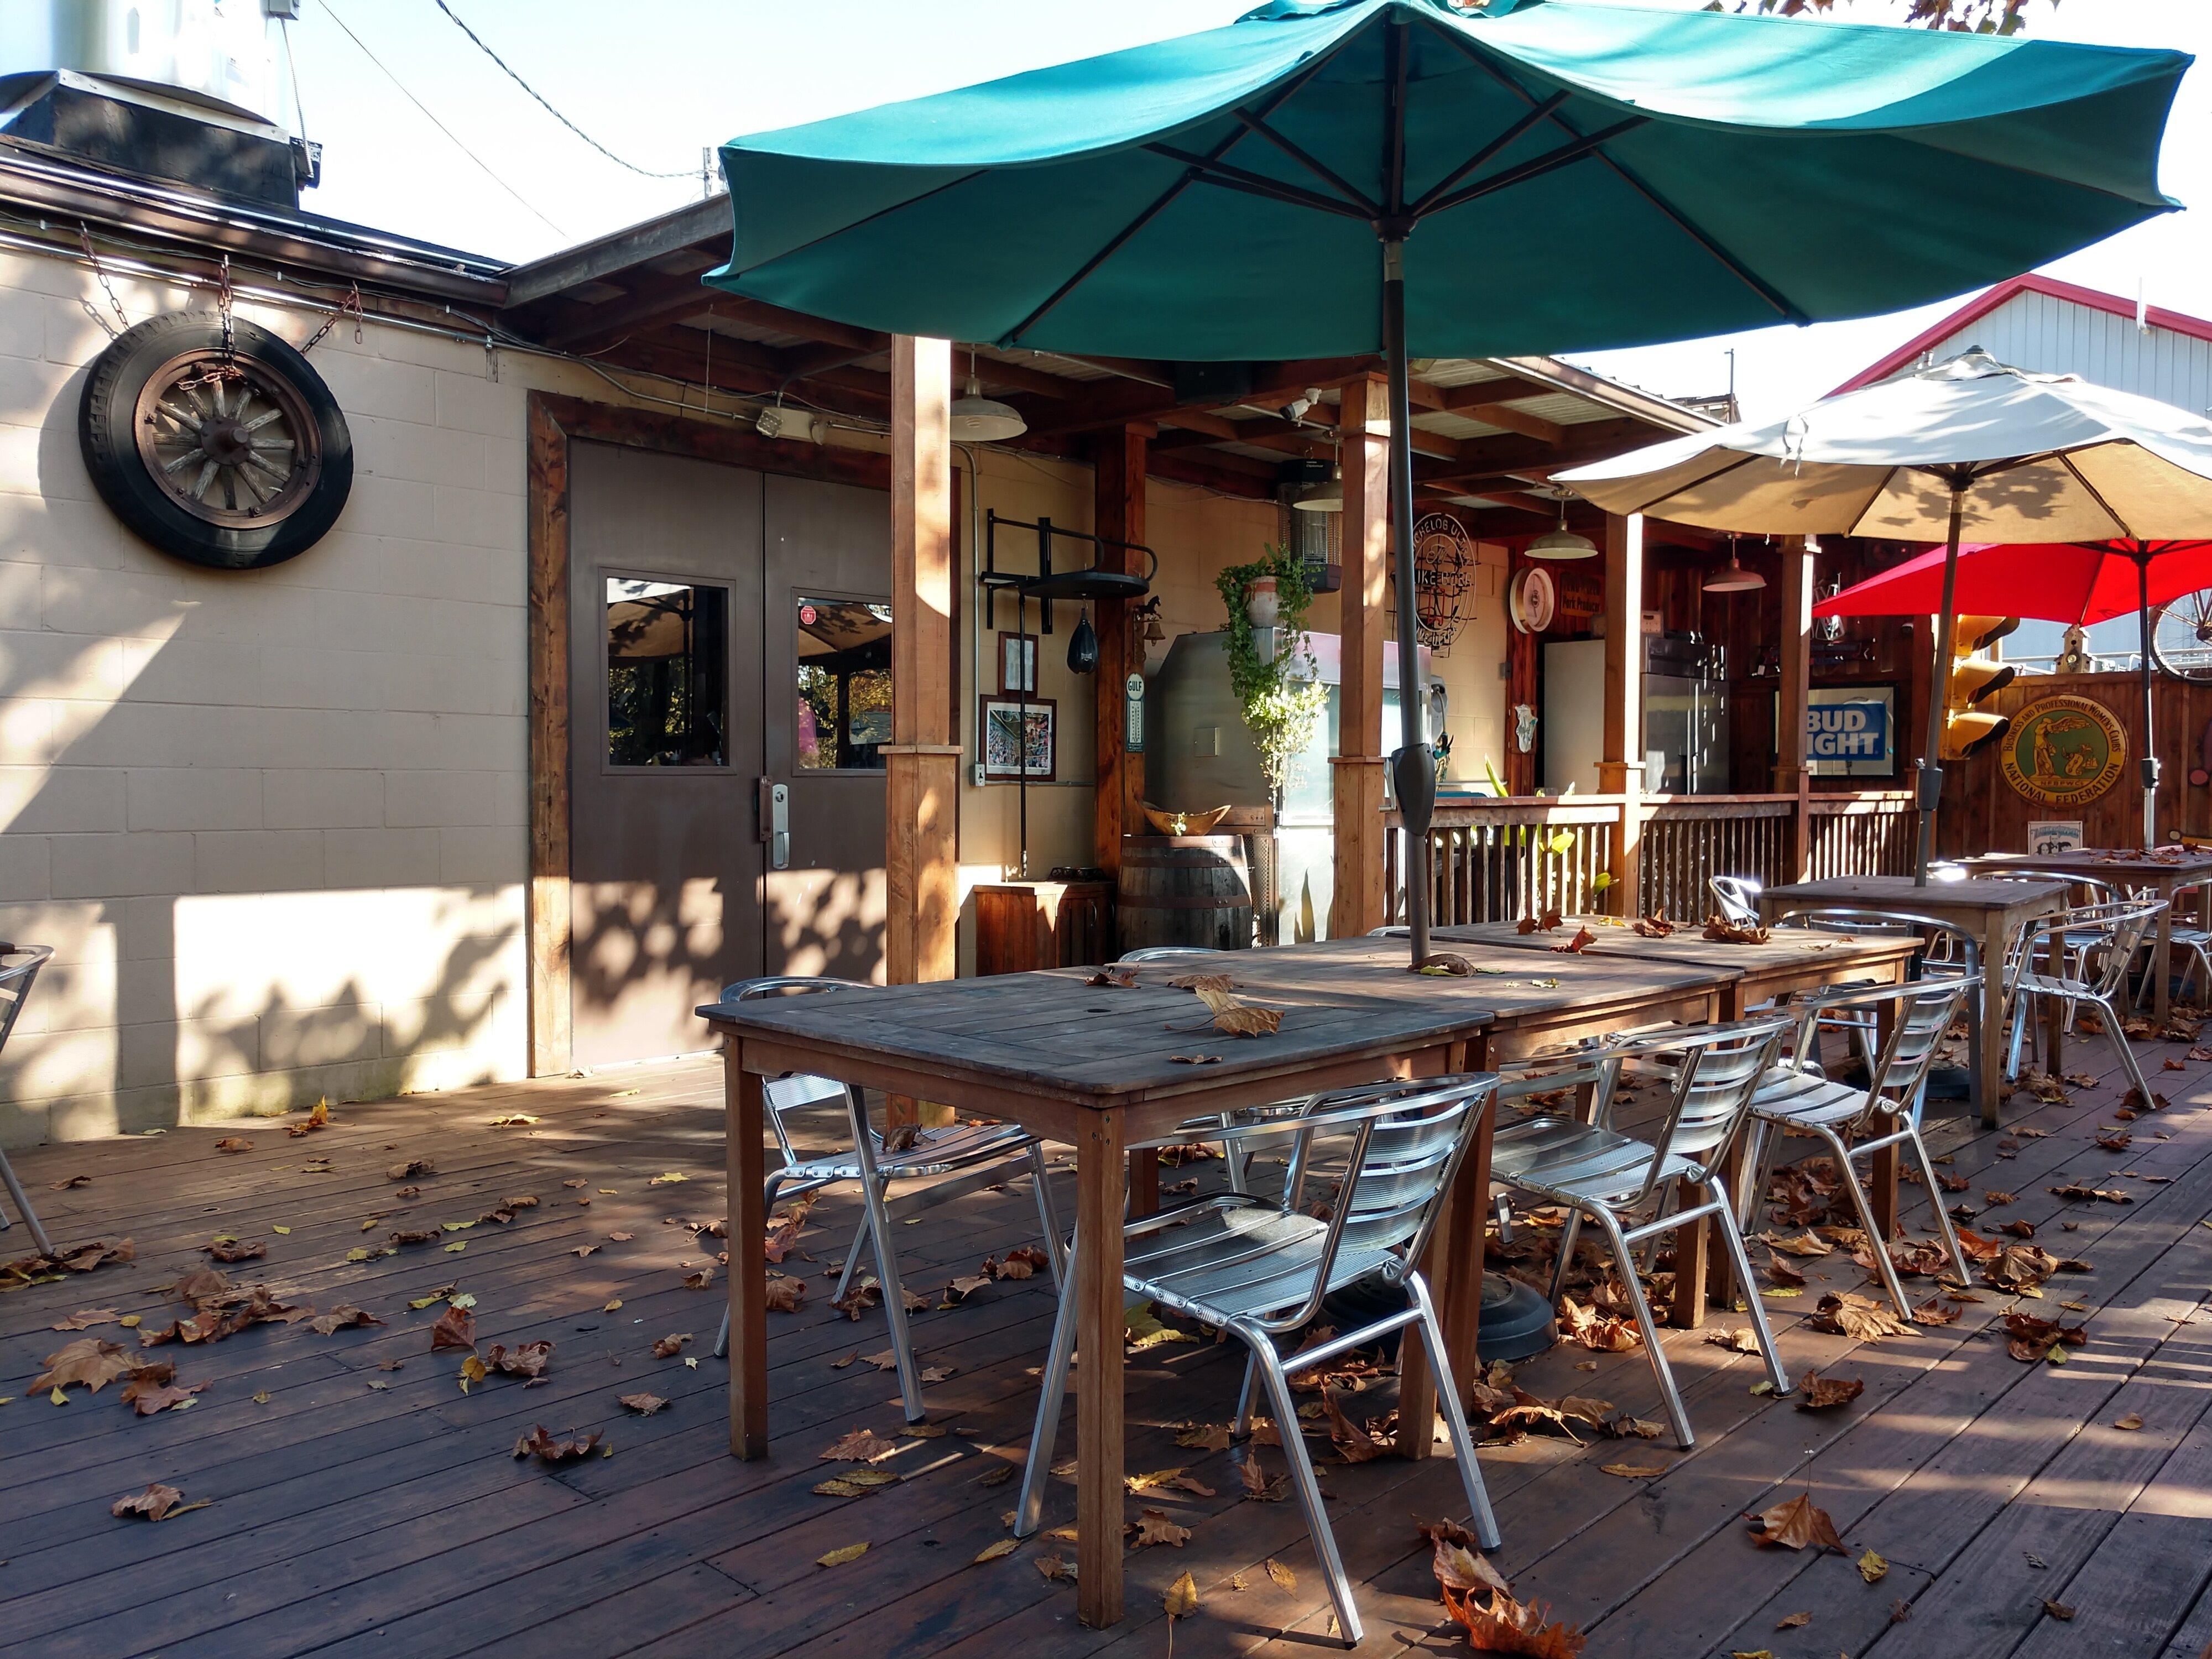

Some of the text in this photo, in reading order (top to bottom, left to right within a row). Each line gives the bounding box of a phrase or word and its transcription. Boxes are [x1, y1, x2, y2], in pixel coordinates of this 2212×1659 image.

[1413, 518, 1448, 548] ICHELOB
[1415, 570, 1436, 585] IKE
[1128, 681, 1142, 691] GULF
[1807, 711, 1866, 732] BUD
[2004, 721, 2024, 752] BUSINESS
[2022, 709, 2035, 722] AND
[2035, 699, 2088, 713] PROFESSIONAL
[2109, 729, 2121, 753] CLUBS
[1807, 733, 1879, 755] IGHT
[2005, 762, 2120, 804] NATIONAL FEDERATION
